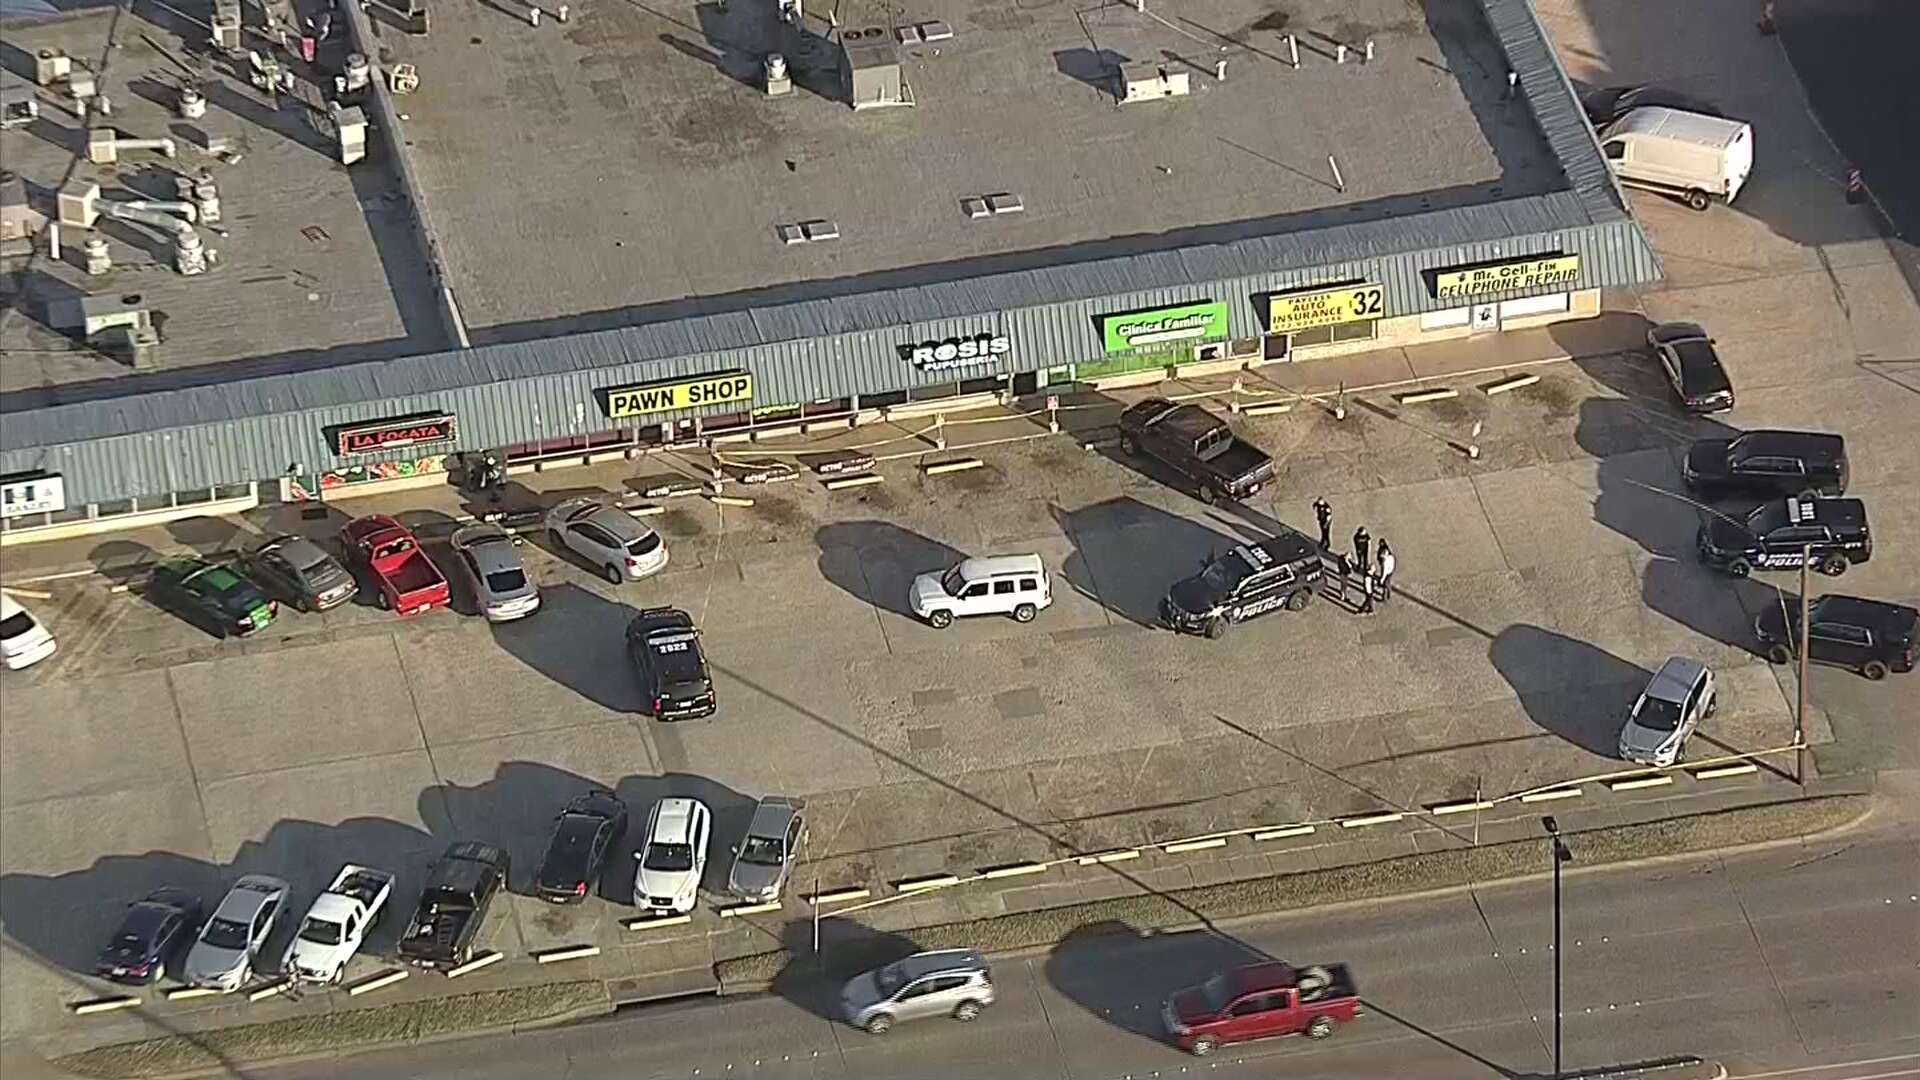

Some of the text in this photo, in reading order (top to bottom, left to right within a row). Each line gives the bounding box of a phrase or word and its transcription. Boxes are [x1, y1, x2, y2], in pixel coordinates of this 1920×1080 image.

[1438, 269, 1578, 298] CELLPHONE REPAIR
[1272, 306, 1343, 324] INSURANCE
[1293, 301, 1325, 313] AUTO
[1164, 314, 1216, 329] Familiar
[912, 337, 1010, 364] ROSIS
[923, 354, 999, 371] PUPUSERIA
[613, 378, 748, 413] PAWN SHOP
[354, 426, 441, 446] LA FOGATA
